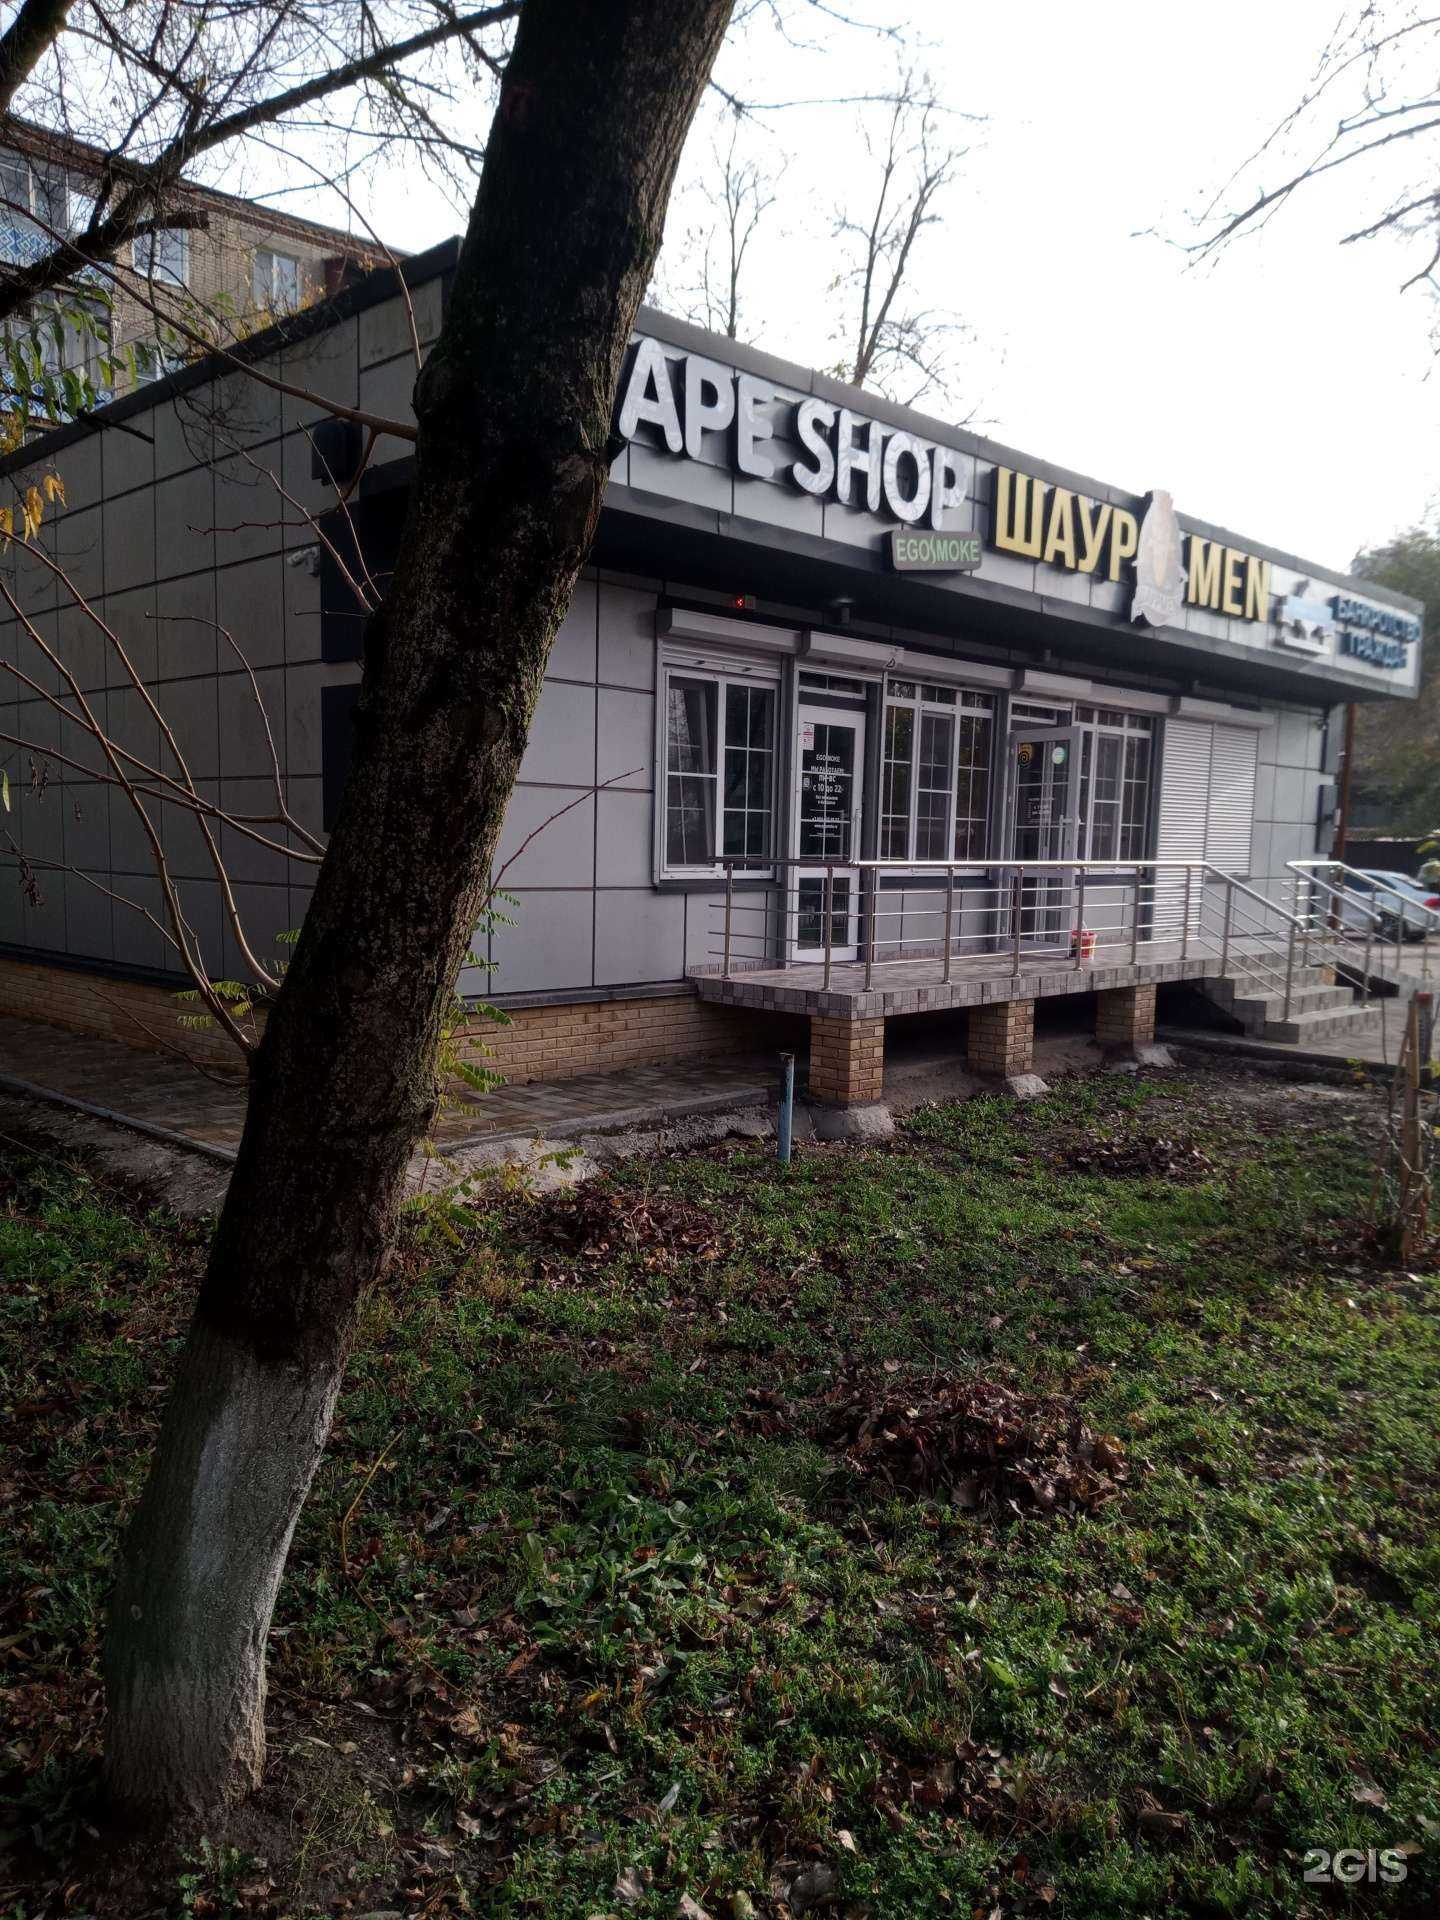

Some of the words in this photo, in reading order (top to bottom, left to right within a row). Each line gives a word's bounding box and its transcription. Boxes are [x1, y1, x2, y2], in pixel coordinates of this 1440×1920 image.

[619, 337, 774, 478] APE
[793, 398, 969, 530] SHOP
[995, 466, 1137, 582] ШАУР
